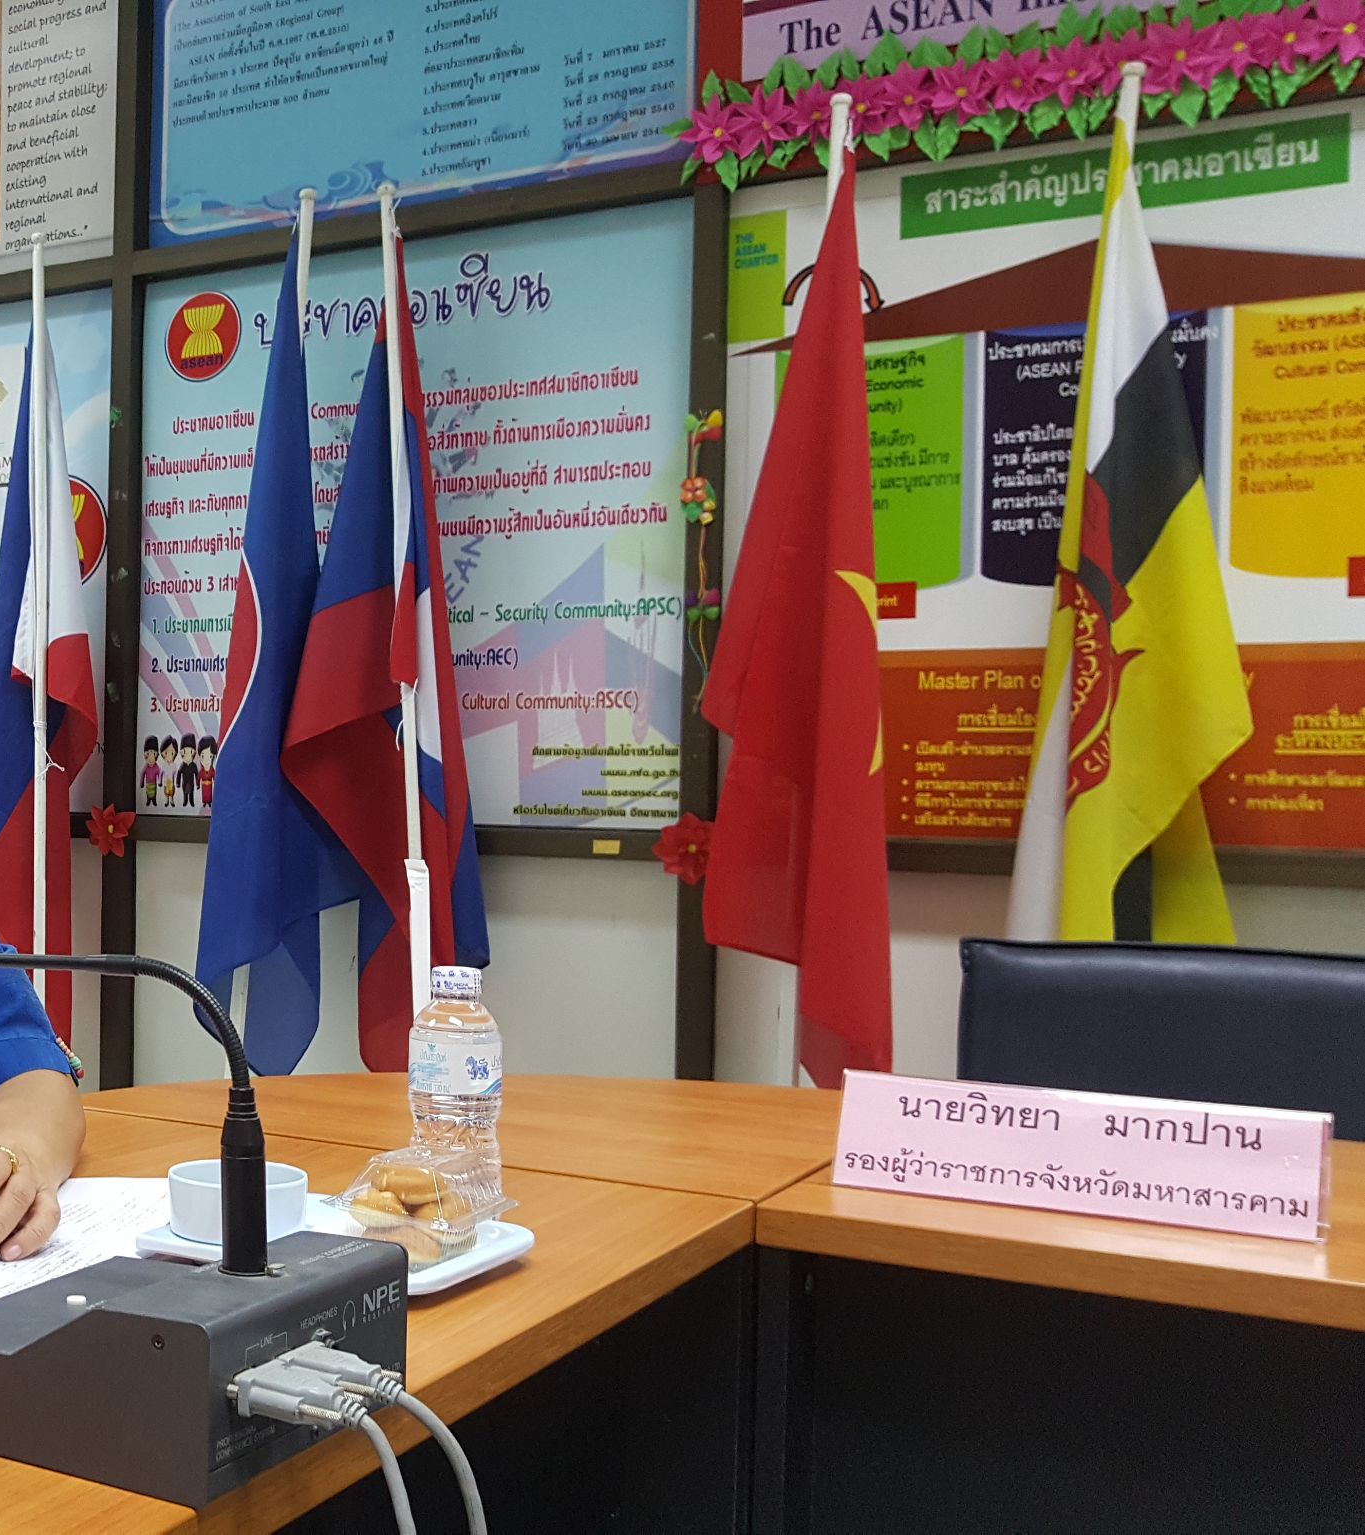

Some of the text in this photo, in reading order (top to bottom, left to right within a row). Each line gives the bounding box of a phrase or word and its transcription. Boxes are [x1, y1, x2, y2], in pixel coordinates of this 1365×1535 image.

[8, 0, 107, 34] social progress and
[779, 0, 995, 55] The ASEAN
[8, 34, 48, 54] cultural
[8, 46, 86, 74] development; to
[8, 64, 92, 97] promote regional
[7, 99, 33, 117] peace
[35, 91, 56, 107] and
[7, 104, 96, 133] to maintain close
[7, 126, 79, 152] and beneficial
[6, 146, 88, 175] cooperation with
[6, 174, 47, 192] existing
[5, 182, 99, 211] international and
[5, 212, 47, 231] regional
[180, 352, 224, 371] asean
[1016, 361, 1071, 382] (ASEAN
[173, 409, 255, 436] ประชาคมอาเซียน
[144, 571, 214, 595] ประกอบด้วย 3
[152, 619, 161, 634] 1.
[495, 602, 549, 623] Security
[554, 597, 682, 622] Community:APSC)
[151, 657, 162, 673] 2.
[451, 647, 519, 671] unity:AEC)
[918, 671, 979, 690] Master
[984, 669, 1024, 689] Plan
[150, 690, 639, 714] 3. Cultural Community:ASCC)
[898, 1091, 1264, 1152] นายวิทยา มากปาน
[844, 1147, 1310, 1220] รองผู้ว่าราชการจังหวัดมหาสารคาม
[363, 1279, 402, 1315] NPE
[300, 1305, 340, 1330] HEADPHONES
[260, 1333, 275, 1350] LINE
